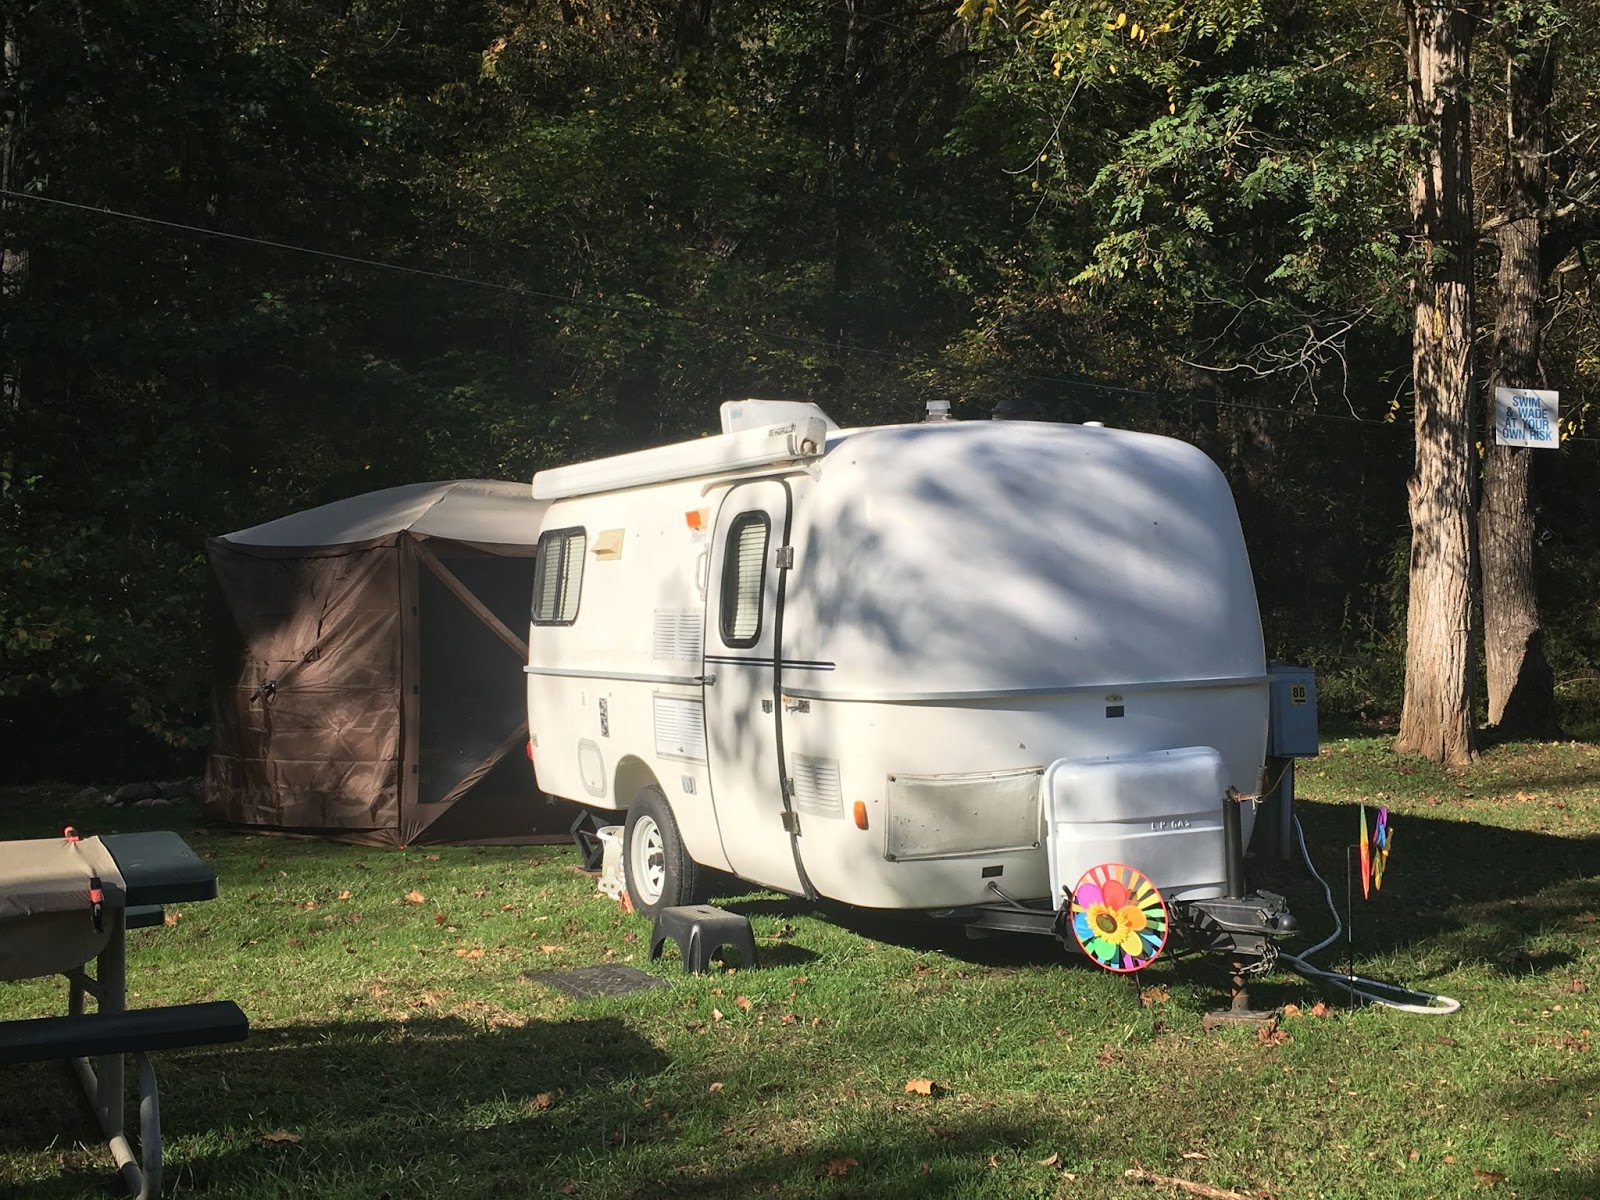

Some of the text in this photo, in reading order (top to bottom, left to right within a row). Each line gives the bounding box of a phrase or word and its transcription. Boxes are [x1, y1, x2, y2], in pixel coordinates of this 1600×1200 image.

[1512, 395, 1540, 407] SWIM
[1506, 407, 1548, 419] & WADE
[1505, 418, 1549, 430] AT YOUR
[1502, 428, 1552, 441] OWN RISK
[1292, 687, 1305, 698] 86
